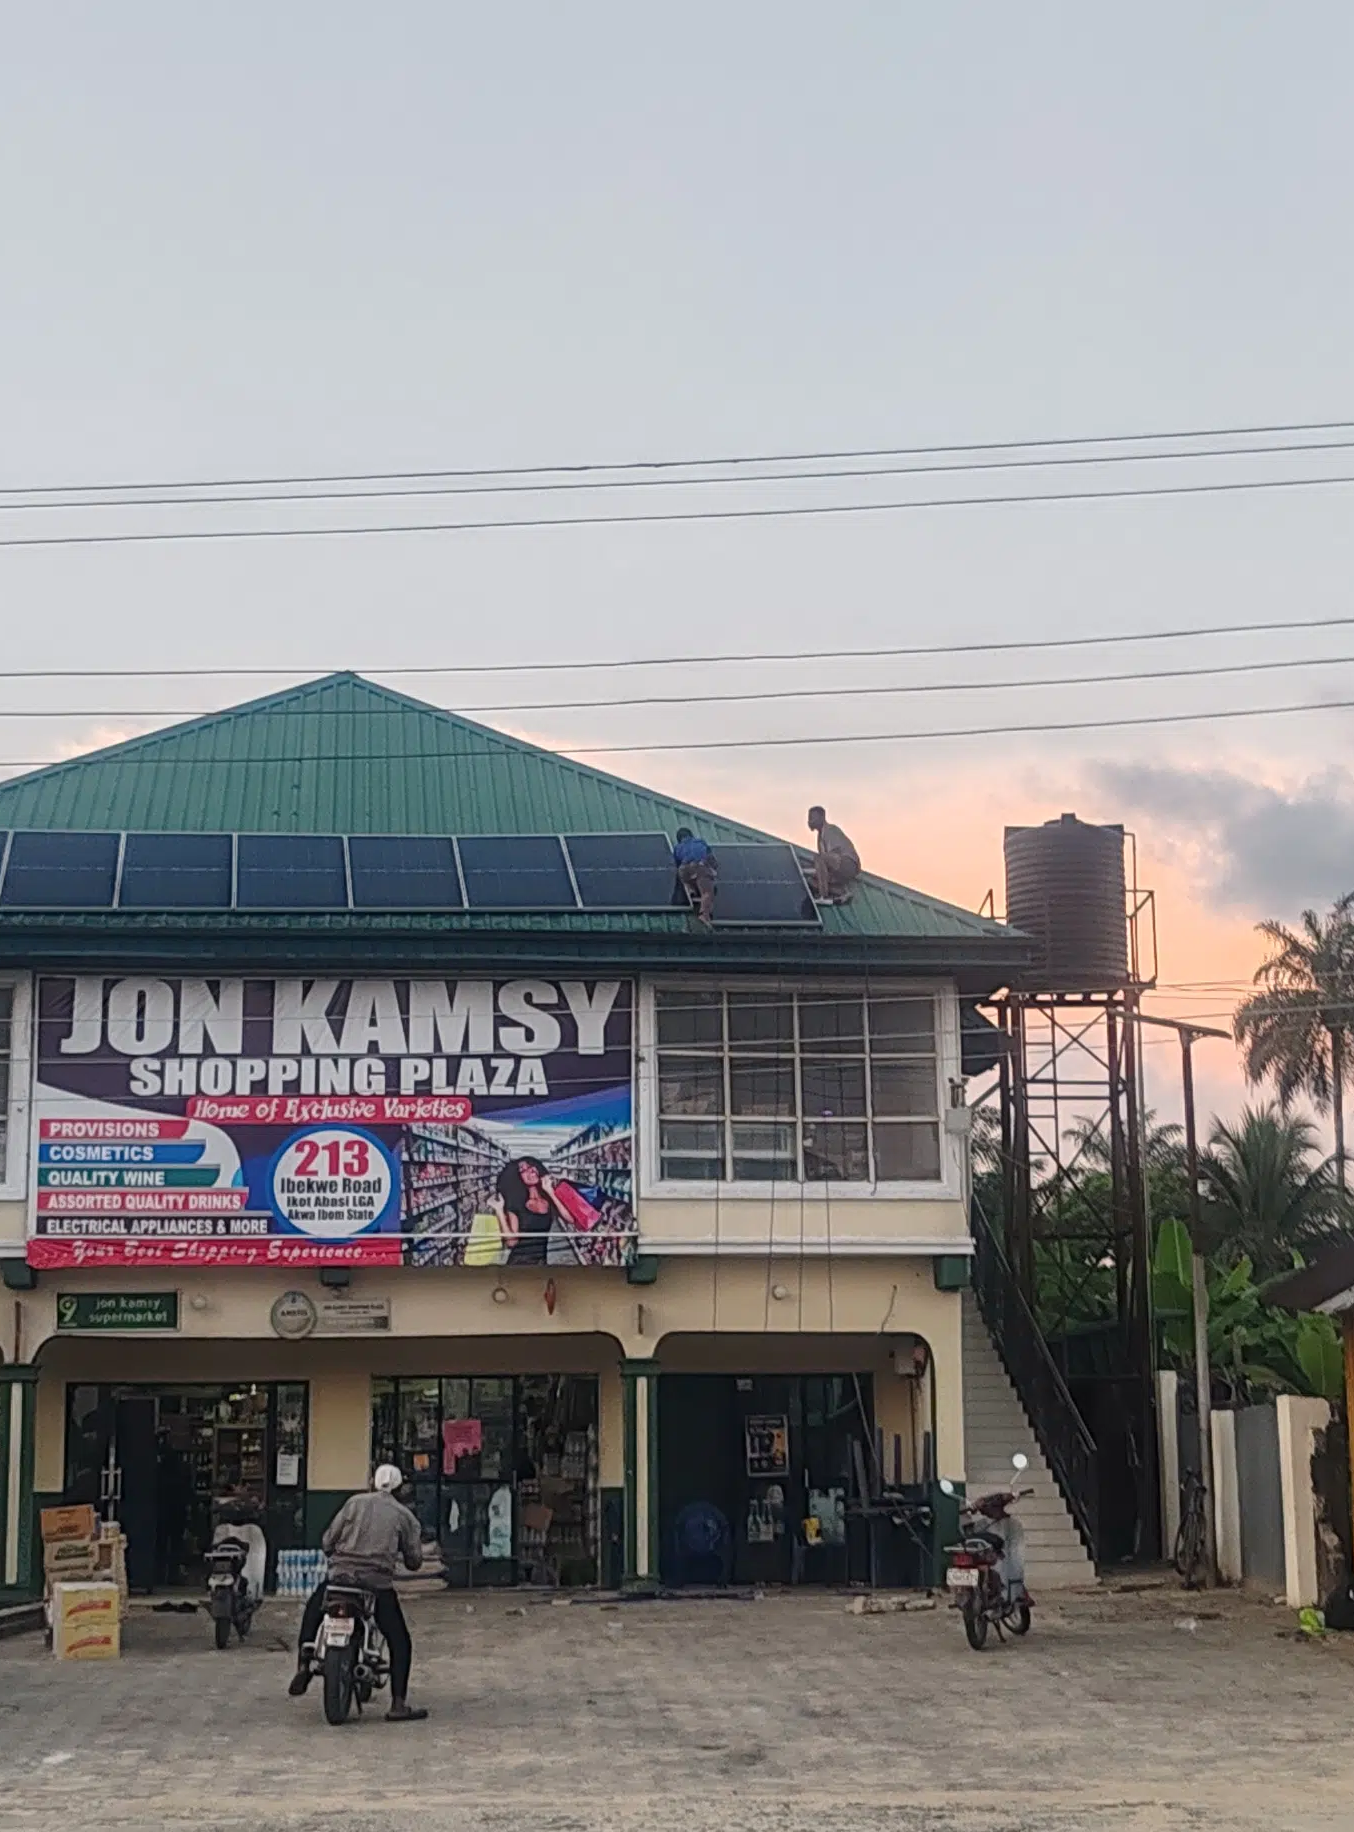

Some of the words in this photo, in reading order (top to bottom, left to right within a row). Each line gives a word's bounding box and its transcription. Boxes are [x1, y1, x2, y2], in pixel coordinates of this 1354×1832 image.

[60, 977, 244, 1055] JON
[272, 978, 622, 1057] KAMSY
[129, 1057, 386, 1097] SHOPPING
[400, 1057, 549, 1096] PLAZA
[193, 1100, 250, 1119] Home
[254, 1100, 279, 1122] of
[285, 1099, 376, 1123] Exclusive
[383, 1100, 466, 1118] Varieties
[49, 1122, 160, 1137] PROVISIONS
[49, 1146, 154, 1161] COSMETICS
[294, 1140, 370, 1177] 213
[48, 1171, 119, 1186] QUALITY
[123, 1171, 165, 1185] WINE
[280, 1177, 339, 1194] Ibekwe
[342, 1177, 382, 1194] Road
[48, 1194, 122, 1209] ASSORTED
[125, 1194, 185, 1209] QUALITY
[188, 1194, 241, 1209] DRINKS
[286, 1196, 312, 1207] Ikot
[314, 1196, 350, 1207] Abasi
[352, 1196, 375, 1207] LGA
[287, 1210, 316, 1220] Akwa
[318, 1209, 345, 1220] Ibom
[347, 1209, 375, 1220] State
[47, 1219, 127, 1234] ELECTRICAL
[130, 1219, 213, 1234] APPLIANCES
[216, 1219, 226, 1234] &
[229, 1219, 268, 1233] MORE
[96, 1297, 116, 1310] jon
[88, 1310, 168, 1325] supermarket
